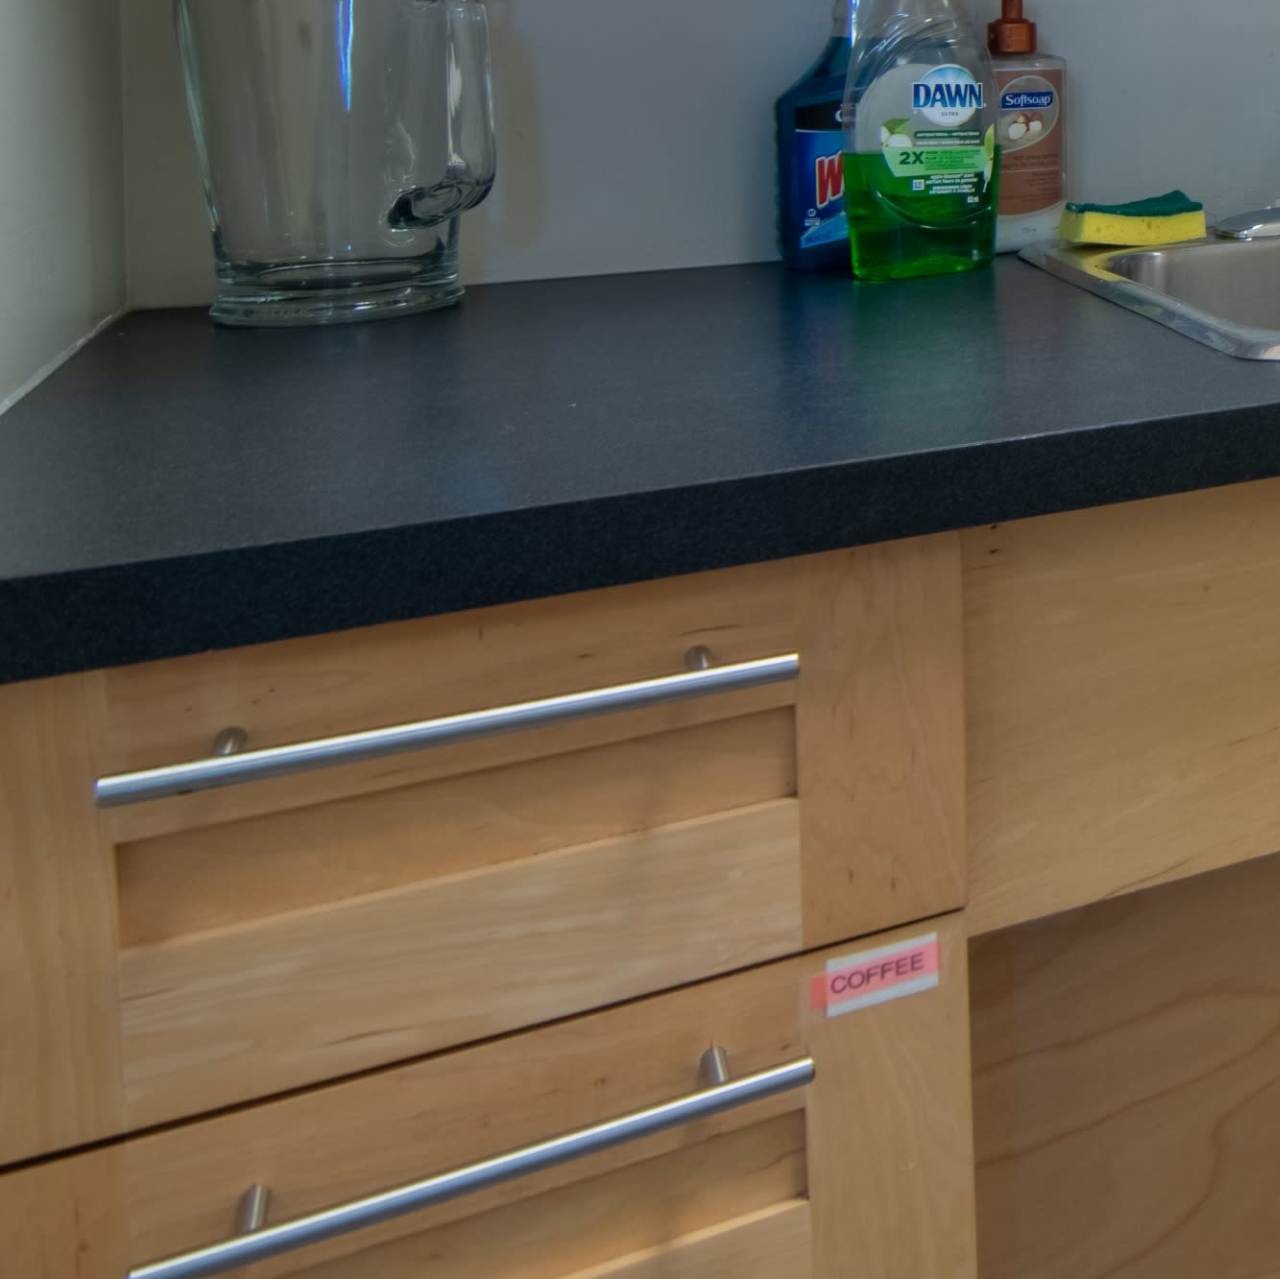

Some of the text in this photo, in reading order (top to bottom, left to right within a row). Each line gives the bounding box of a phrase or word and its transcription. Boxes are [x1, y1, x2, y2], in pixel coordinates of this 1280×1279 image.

[912, 83, 983, 108] DAWN
[1005, 94, 1051, 107] Softsoap
[899, 151, 925, 165] 2X
[830, 952, 924, 994] COFFEE
